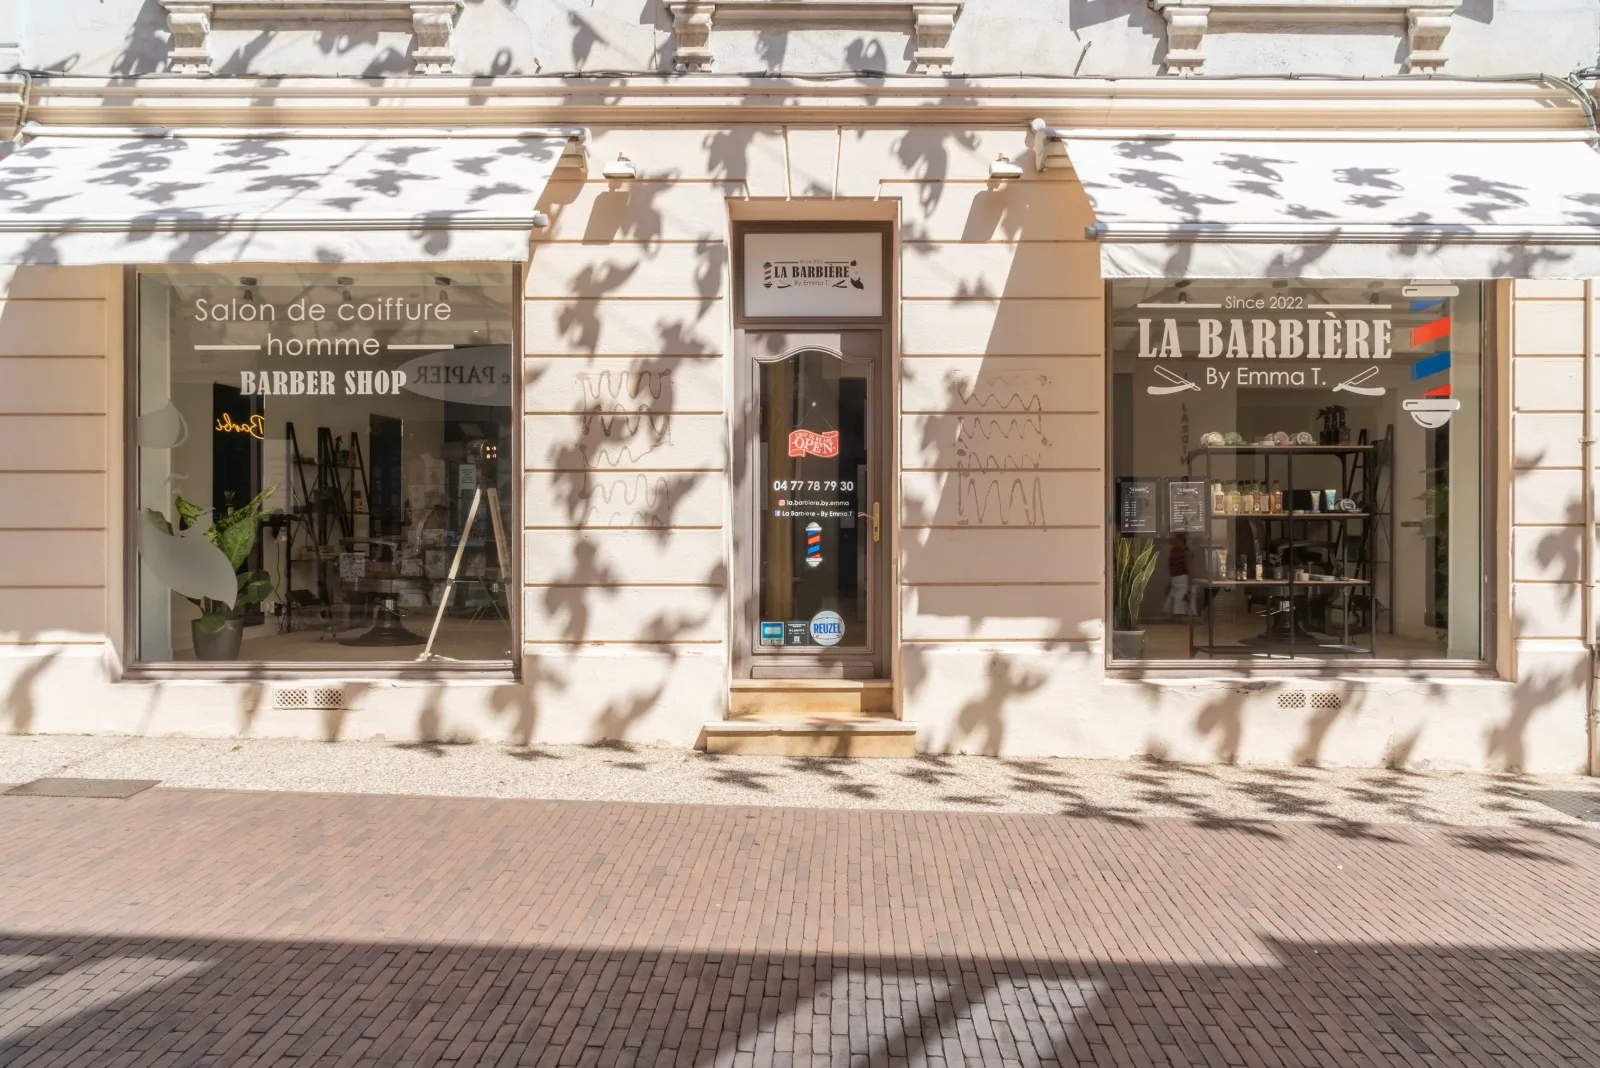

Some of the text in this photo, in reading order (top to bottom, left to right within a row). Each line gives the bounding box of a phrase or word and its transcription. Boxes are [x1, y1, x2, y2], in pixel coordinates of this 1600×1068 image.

[774, 264, 850, 278] LA BARBIÈRE
[195, 298, 452, 321] Salon de coiffure
[1225, 296, 1303, 309] Since 2022
[268, 333, 380, 355] homme
[1138, 311, 1392, 359] LA BARBIÈRE
[240, 370, 407, 396] BARBER SHOP
[1206, 367, 1230, 389] By
[1237, 367, 1305, 386] Emma
[1311, 367, 1326, 386] T.
[794, 436, 833, 454] OPEN
[773, 480, 854, 491] 04 77 78 79 30
[820, 510, 828, 518] By
[813, 622, 842, 634] REUZEL
